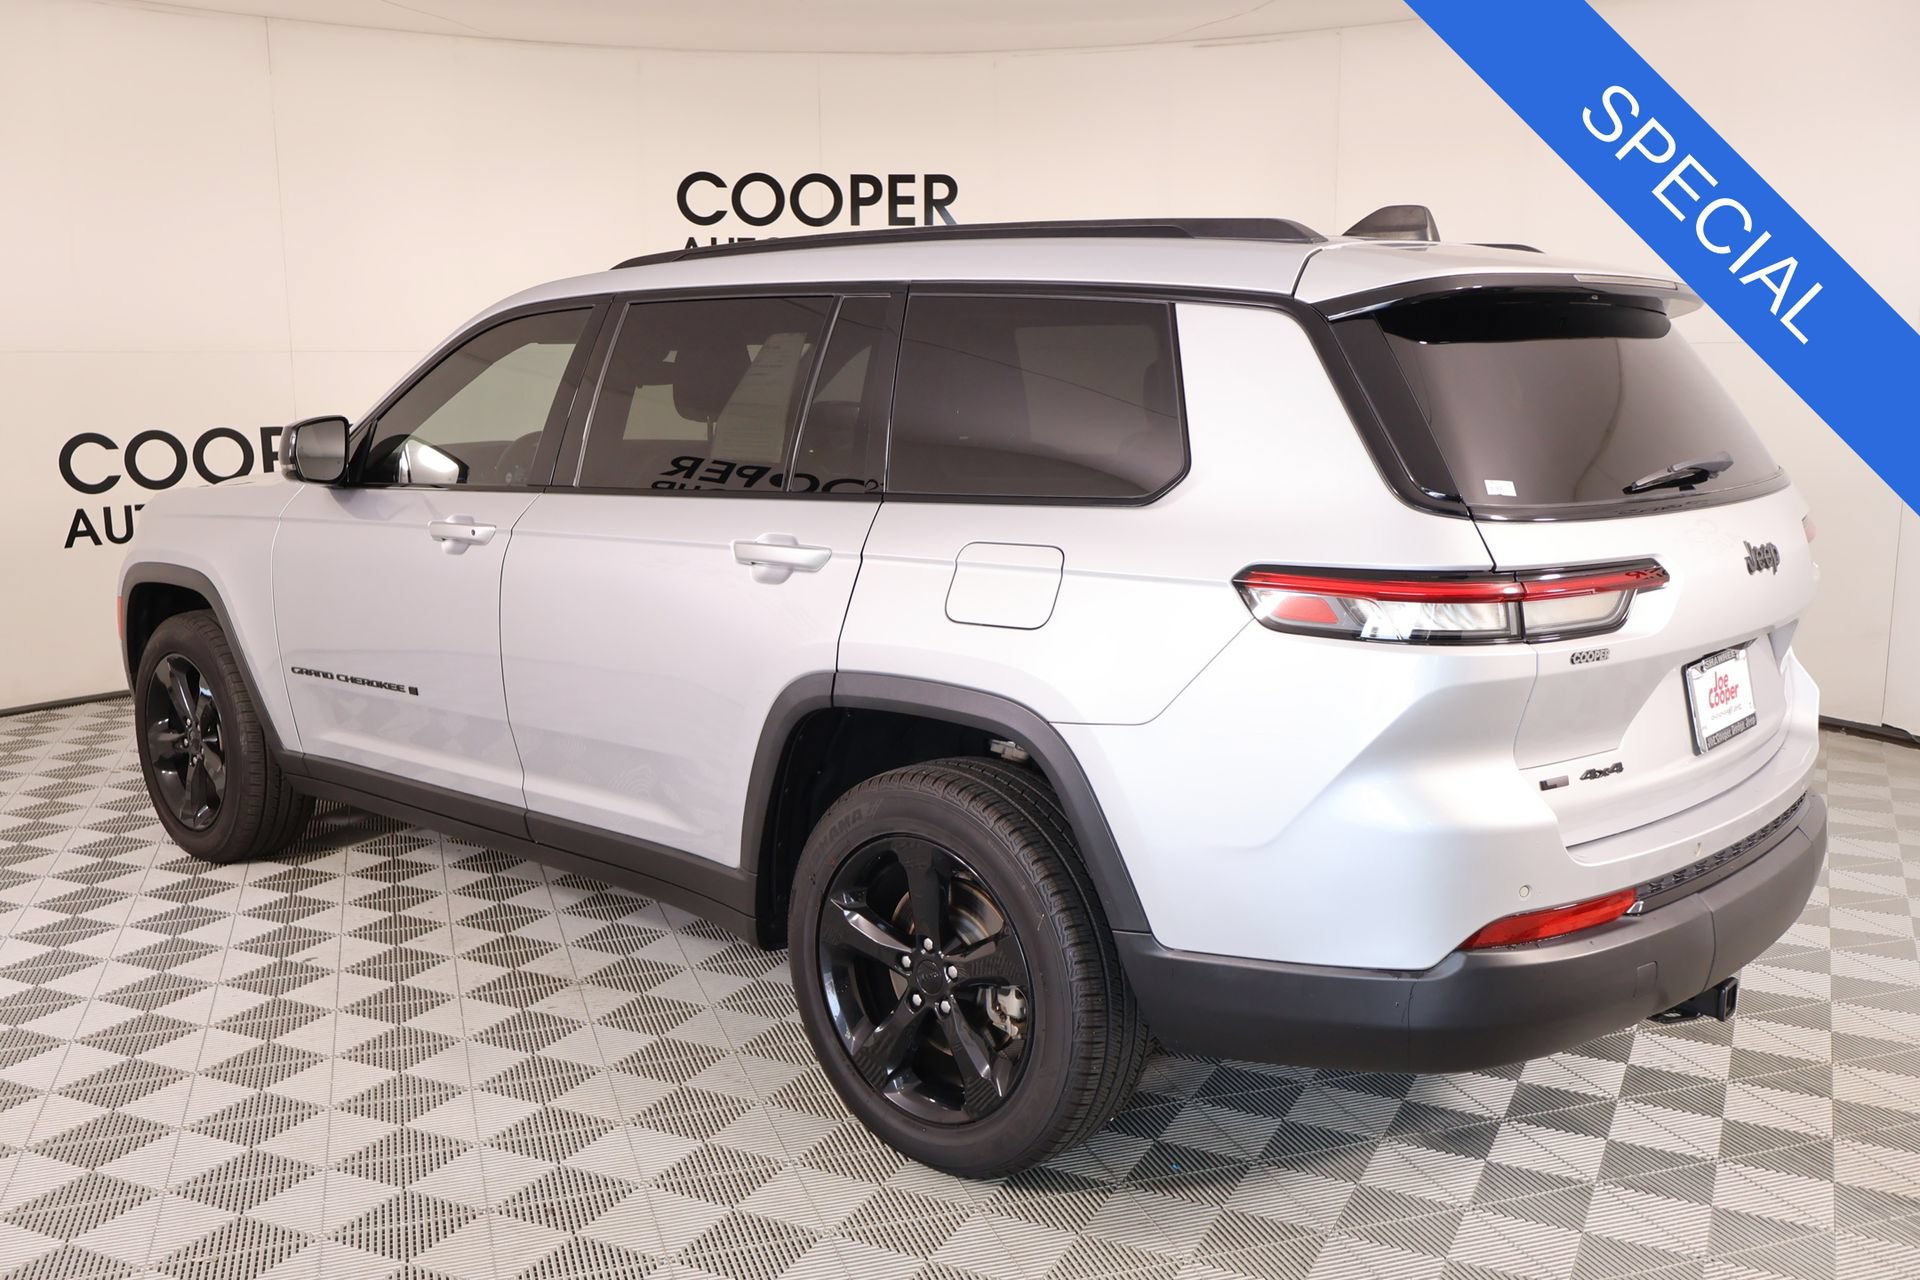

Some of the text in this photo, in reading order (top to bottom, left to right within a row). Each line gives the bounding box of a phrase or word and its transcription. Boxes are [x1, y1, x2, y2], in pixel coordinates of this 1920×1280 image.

[676, 171, 959, 227] COOPER
[58, 427, 284, 494] COOP
[64, 503, 146, 549] AU
[1743, 540, 1780, 575] Jeep
[1570, 648, 1610, 665] COOPER
[291, 666, 335, 680] GRAND
[336, 674, 407, 693] CHEROKEE
[1713, 671, 1729, 692] Joe
[1708, 683, 1740, 709] Cooper
[1579, 761, 1624, 780] 4x4
